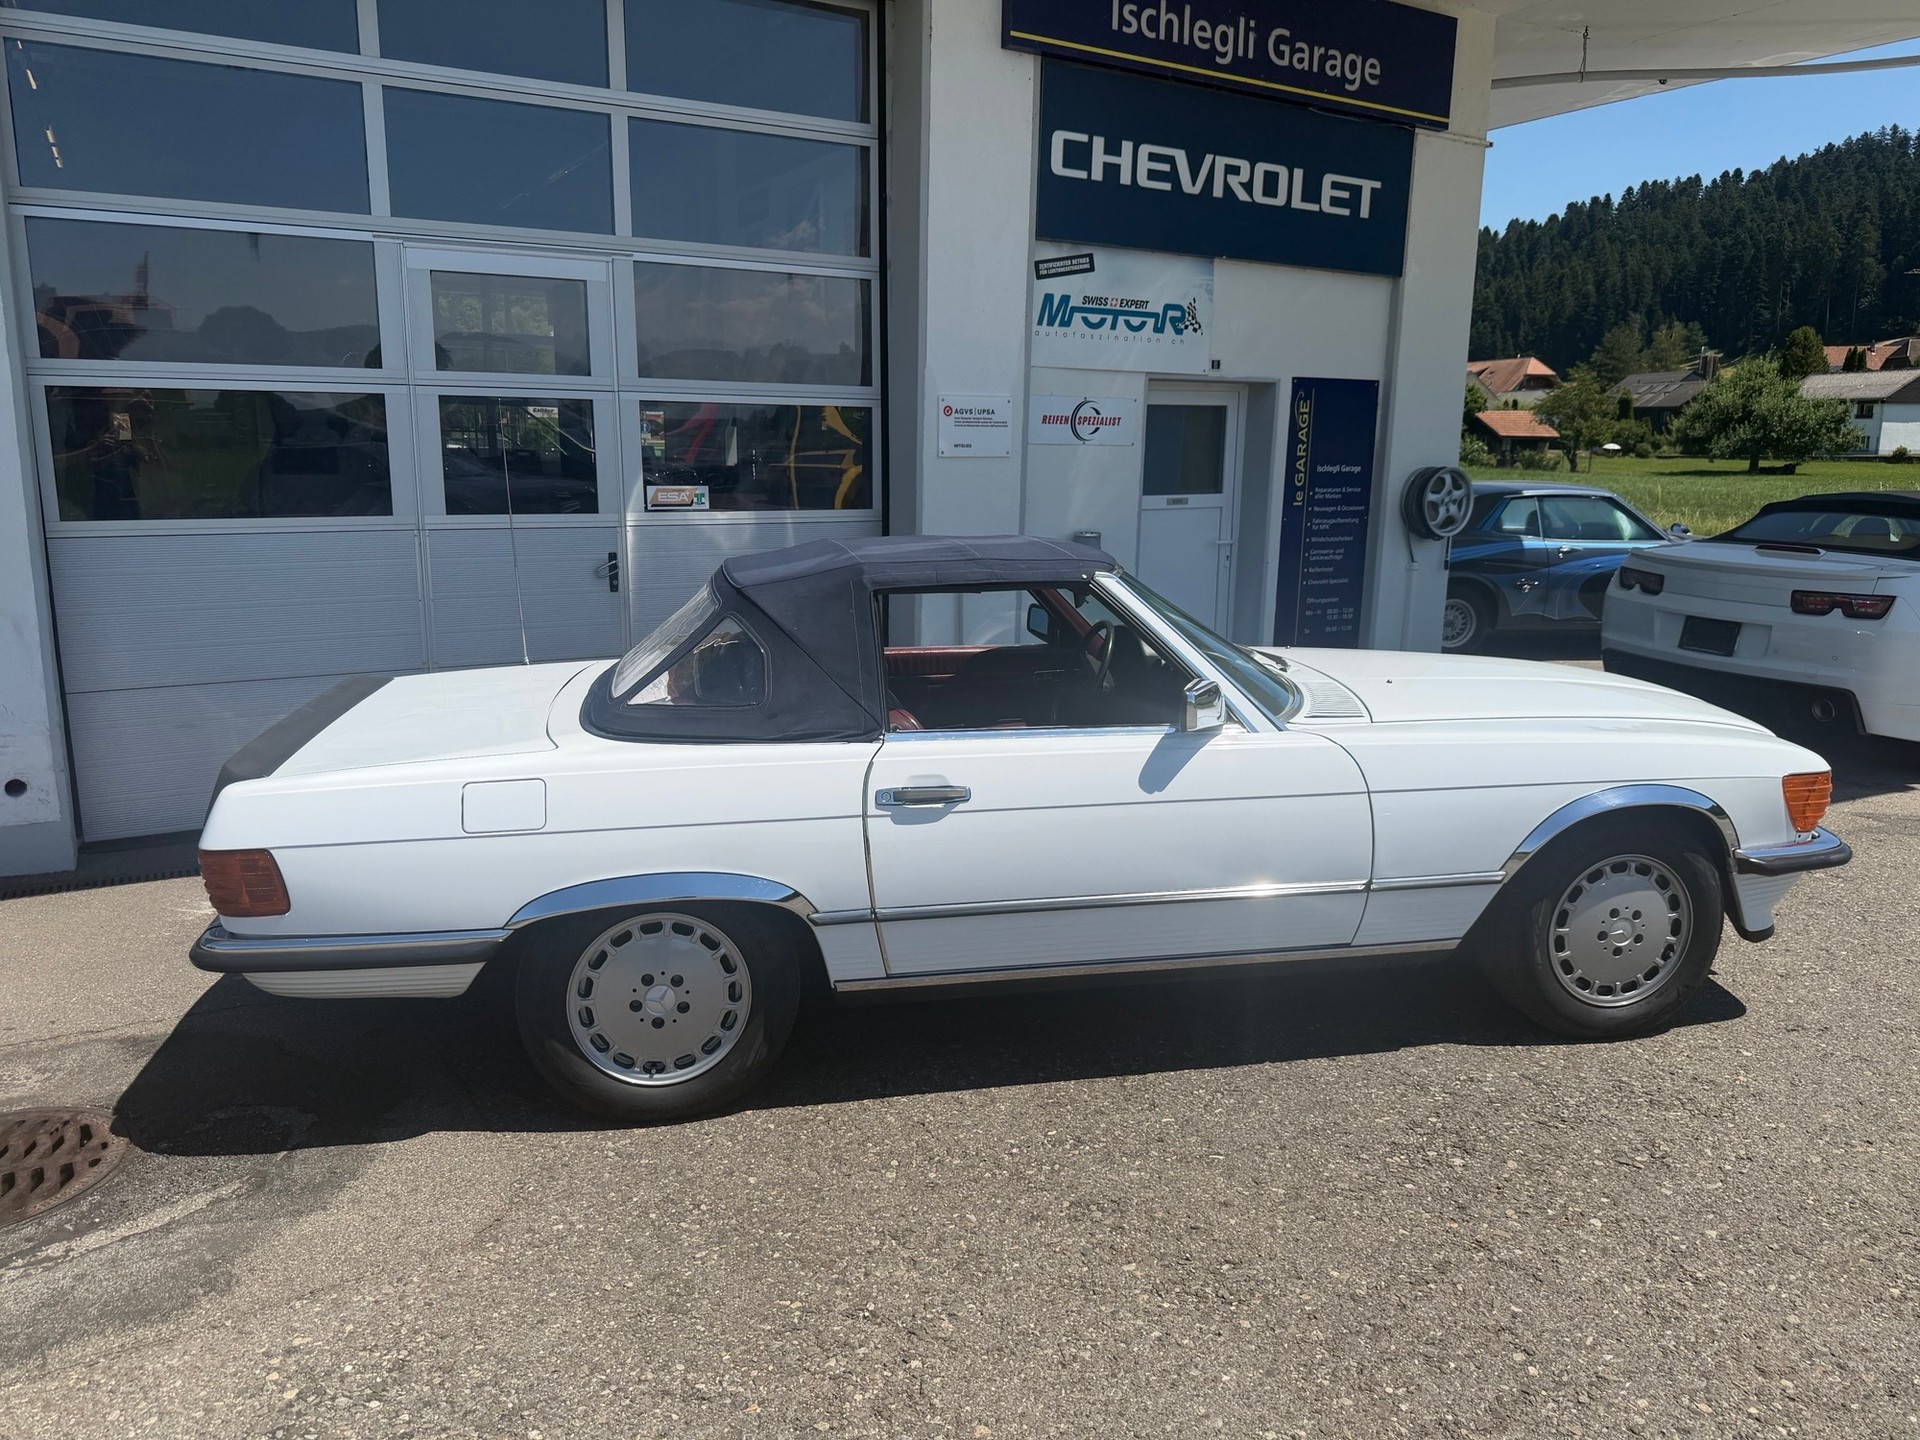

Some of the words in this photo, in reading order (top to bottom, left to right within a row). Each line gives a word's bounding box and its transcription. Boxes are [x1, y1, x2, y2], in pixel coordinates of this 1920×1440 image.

[1111, 0, 1256, 65] Ischlegli
[1267, 27, 1382, 92] Garage
[1050, 129, 1382, 220] CHEVROLET
[1081, 295, 1109, 307] SWISS
[1119, 298, 1150, 310] EXPERT
[977, 408, 996, 416] UPSA
[1041, 414, 1070, 425] REIFEN
[1077, 415, 1122, 427] SPEZIALIST
[1294, 399, 1310, 487] GARAGE
[1316, 464, 1340, 474] Ischlegli
[1340, 464, 1362, 474] Garage
[1292, 491, 1304, 506] le
